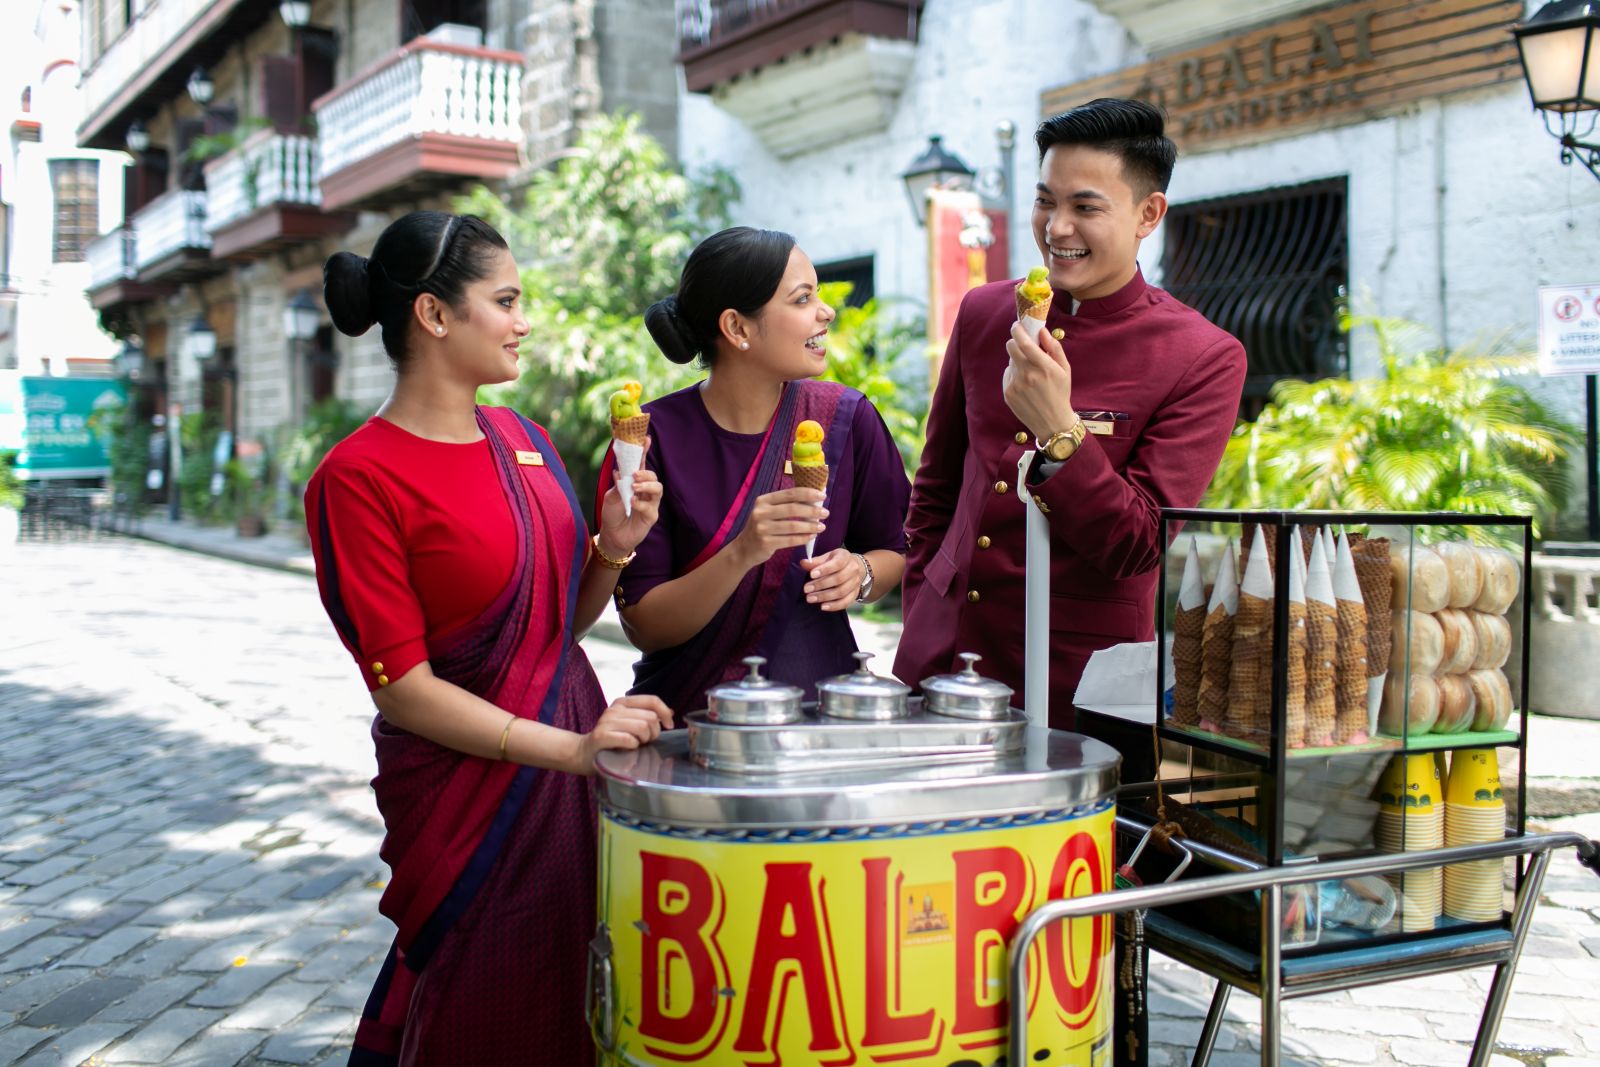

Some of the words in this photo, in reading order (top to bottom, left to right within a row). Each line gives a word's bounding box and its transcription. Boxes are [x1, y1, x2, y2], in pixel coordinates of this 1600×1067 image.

[1176, 9, 1376, 107] BALAI
[1580, 320, 1599, 328] NO
[638, 823, 1116, 1067] BALBO
